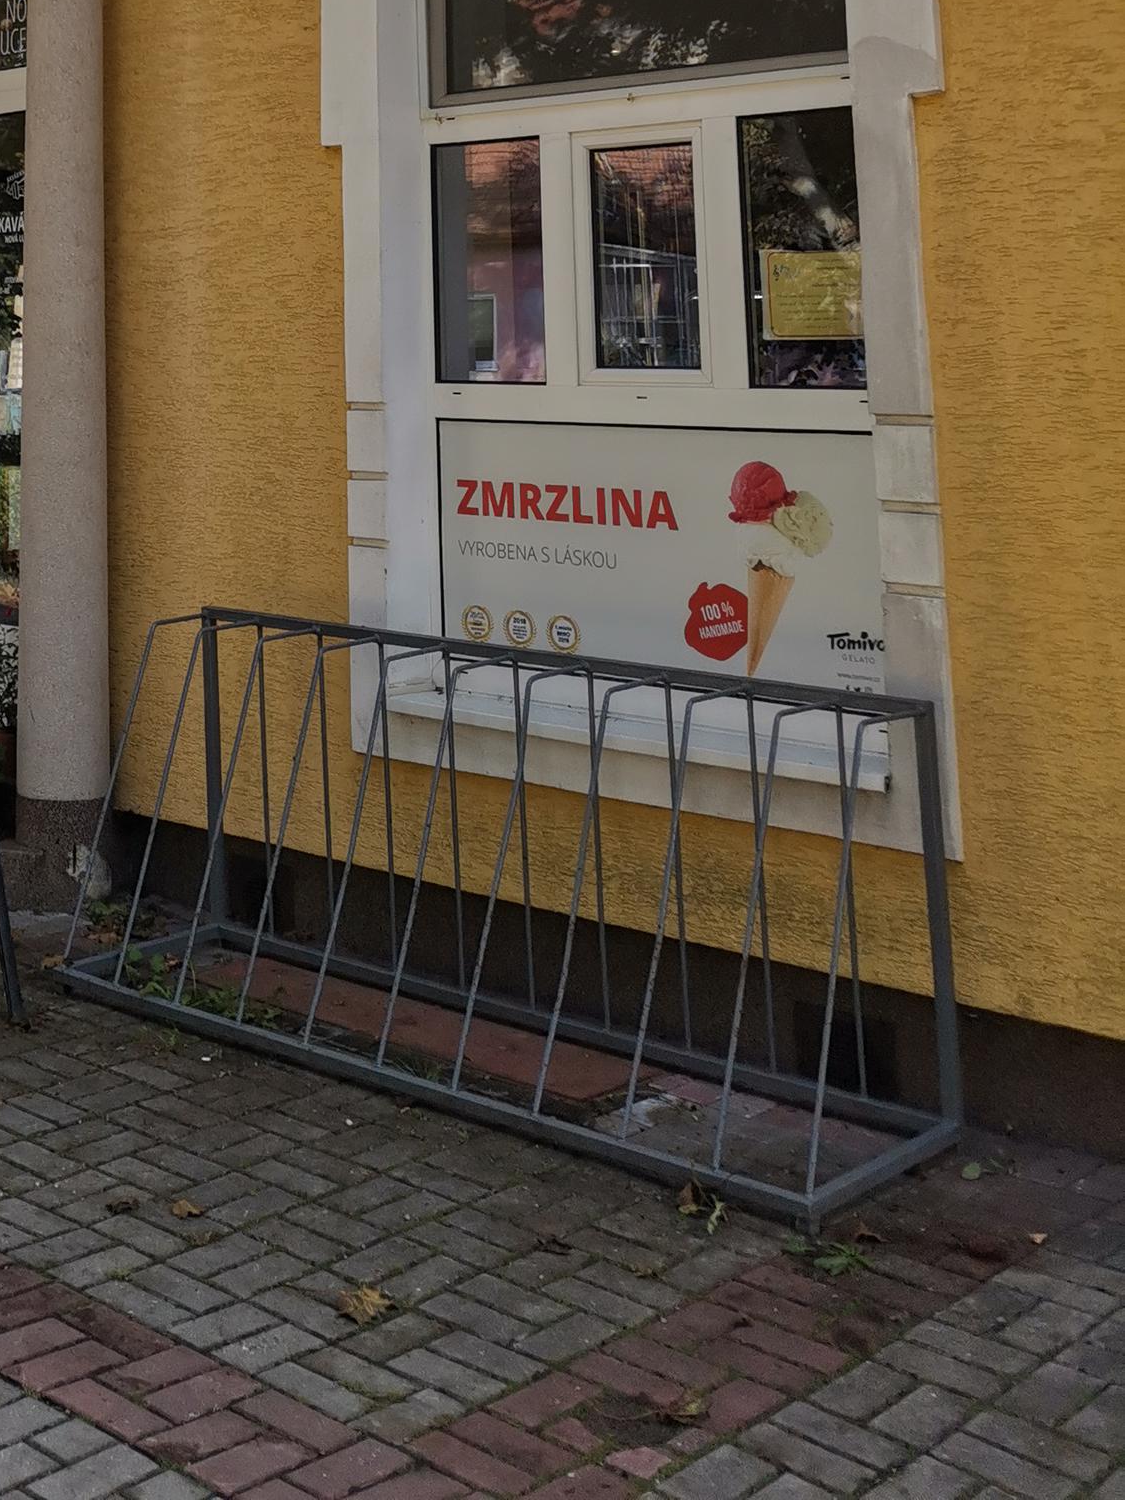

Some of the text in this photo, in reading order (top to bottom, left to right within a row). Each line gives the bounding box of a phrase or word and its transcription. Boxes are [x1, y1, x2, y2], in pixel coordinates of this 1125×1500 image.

[456, 479, 679, 531] ZMRZLINA
[458, 539, 617, 569] VYROBENA S LÁSKOU
[700, 603, 721, 621] 100
[698, 620, 745, 639] HANDMADE
